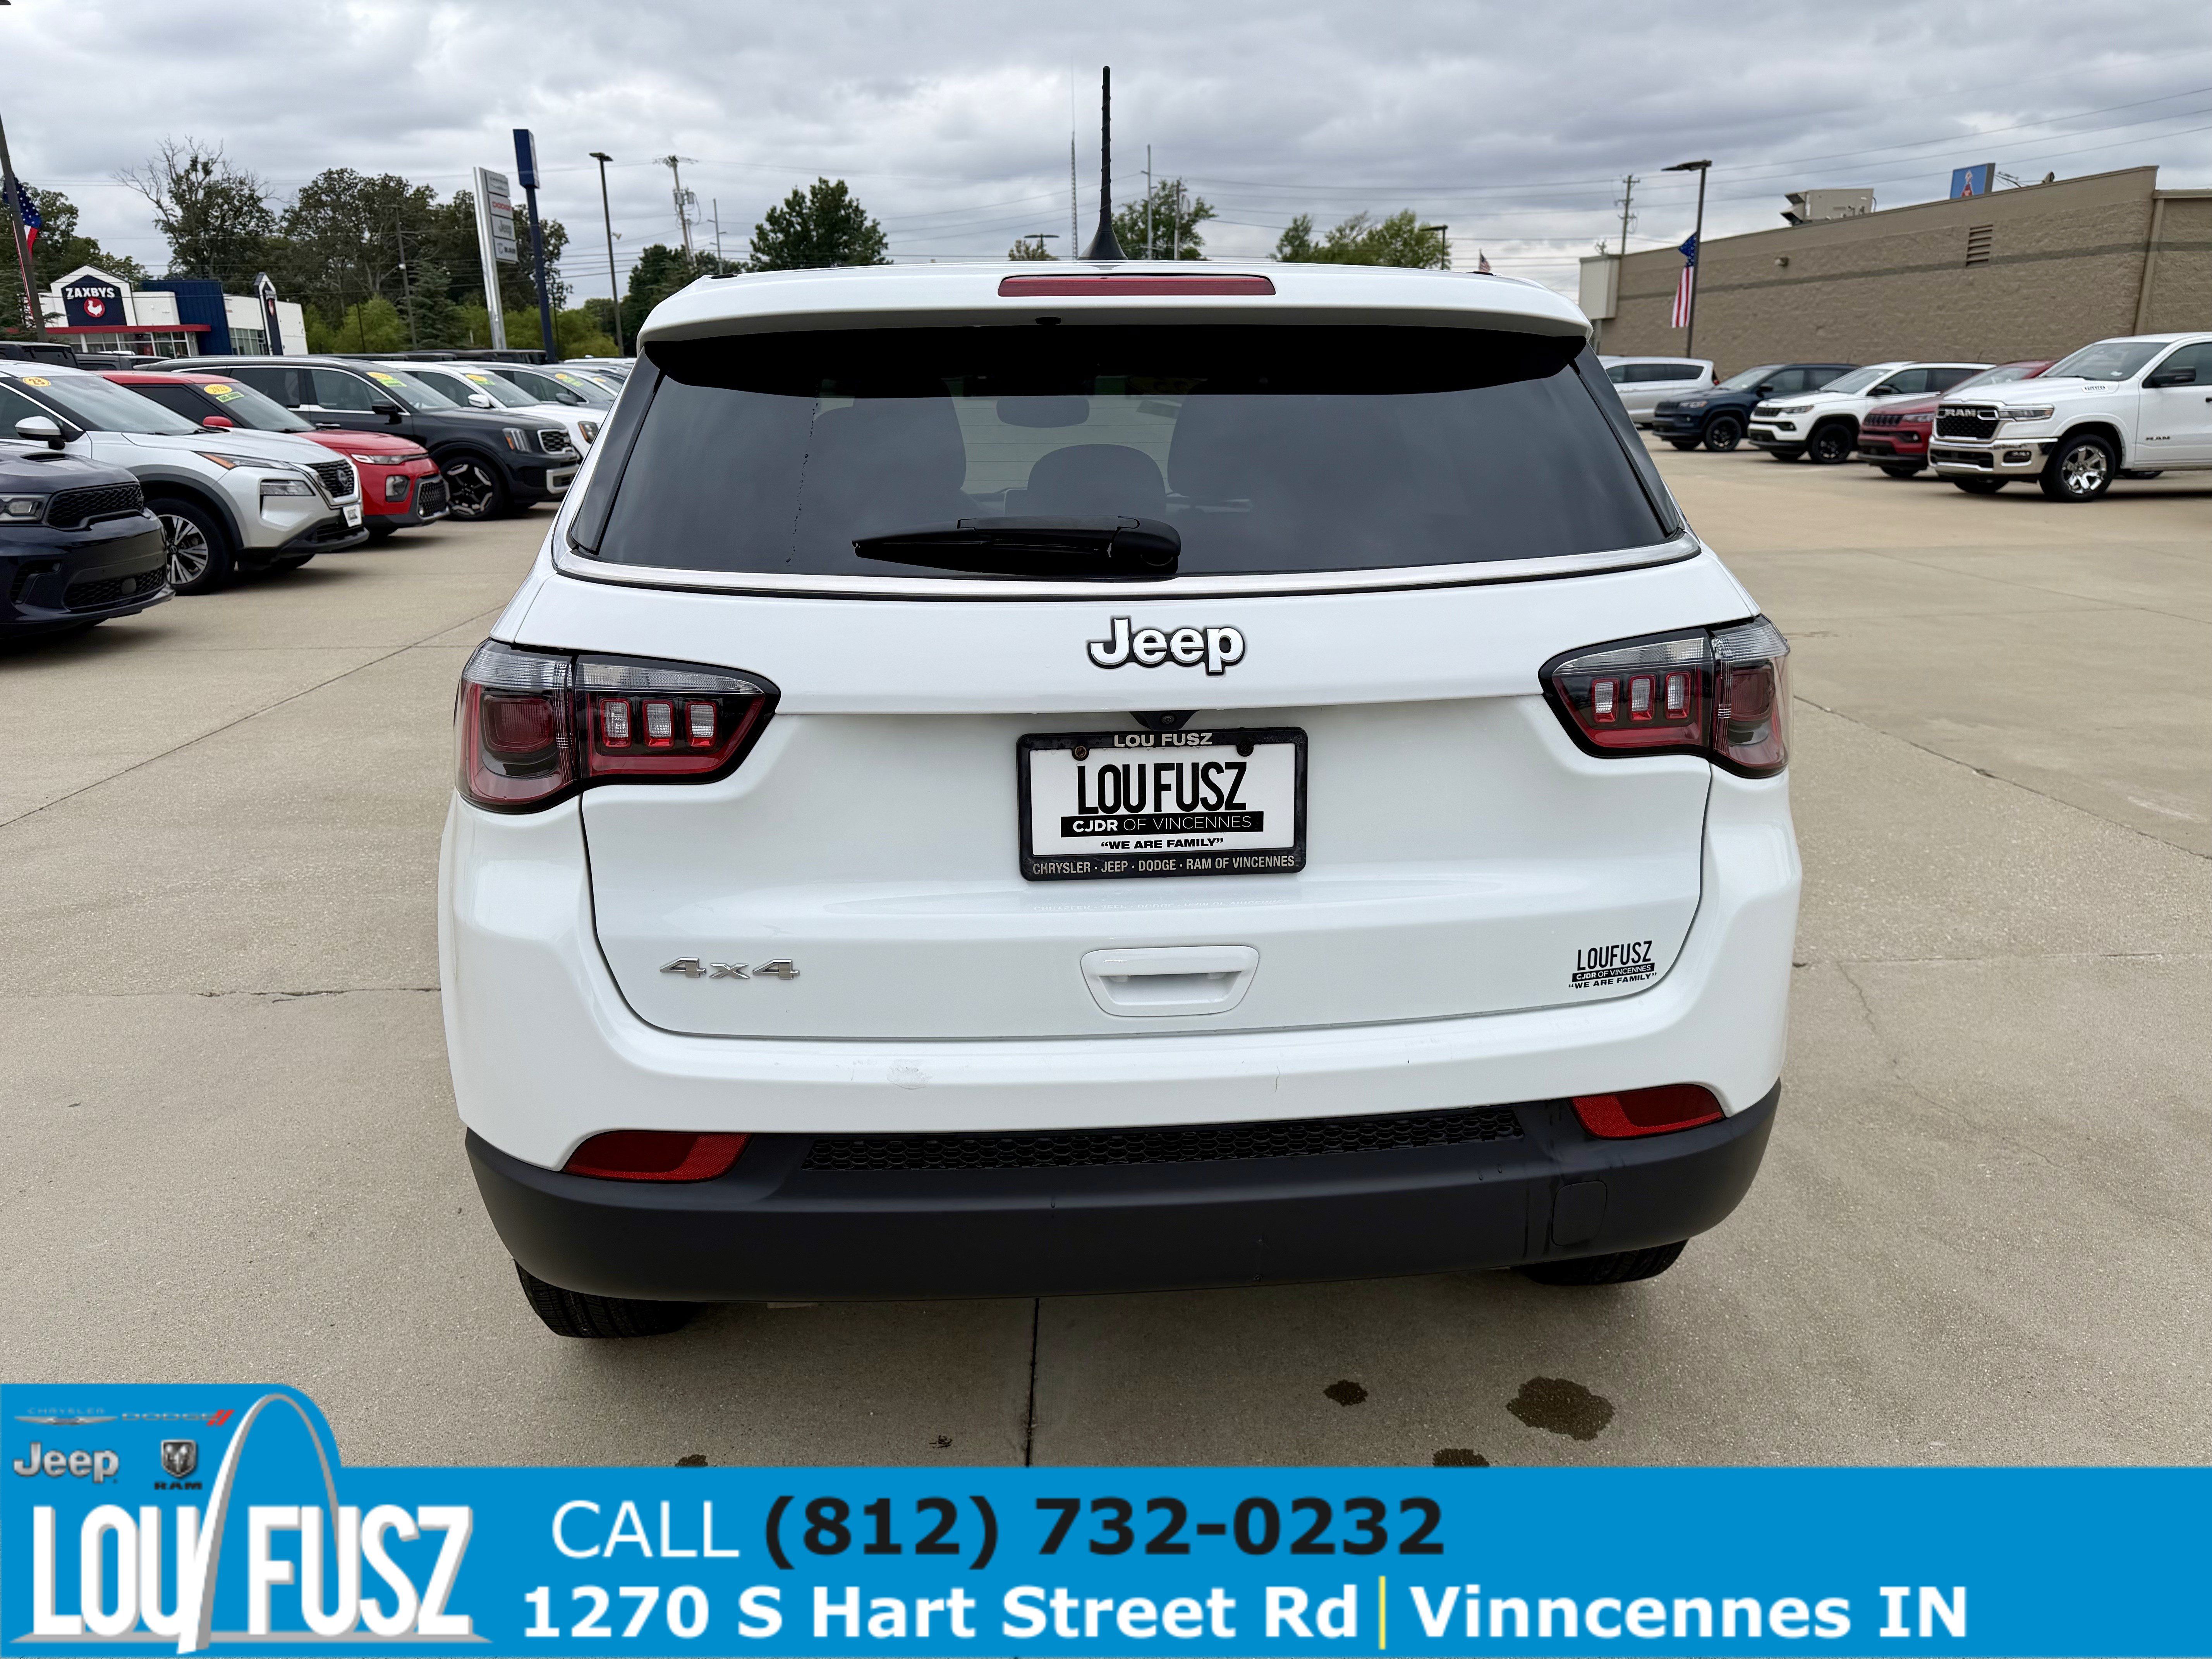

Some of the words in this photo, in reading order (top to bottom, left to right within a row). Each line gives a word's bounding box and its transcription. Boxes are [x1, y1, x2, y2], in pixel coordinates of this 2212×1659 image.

[65, 287, 115, 300] ZAXBYS
[1944, 408, 1976, 417] RAM
[1088, 617, 1245, 675] Jeep
[1114, 734, 1154, 747] LOU
[1161, 733, 1212, 746] FUSZ
[1077, 764, 1147, 815] LOU
[1154, 762, 1247, 812] FUSZ
[1073, 819, 1118, 832] CJDR
[1123, 818, 1147, 831] OF
[1152, 816, 1251, 830] VINCENNES
[1134, 840, 1163, 849] ARE
[1033, 861, 1091, 874] CHRYSLER
[1101, 860, 1128, 872] JEEP
[1139, 859, 1176, 871] DODGE
[1186, 858, 1211, 870] RAM
[1215, 857, 1229, 869] OF
[1232, 855, 1295, 868] VINCENNES
[1576, 972, 1596, 980] CJDR
[1610, 965, 1651, 976] VINCENNES
[1593, 978, 1614, 987] ARE
